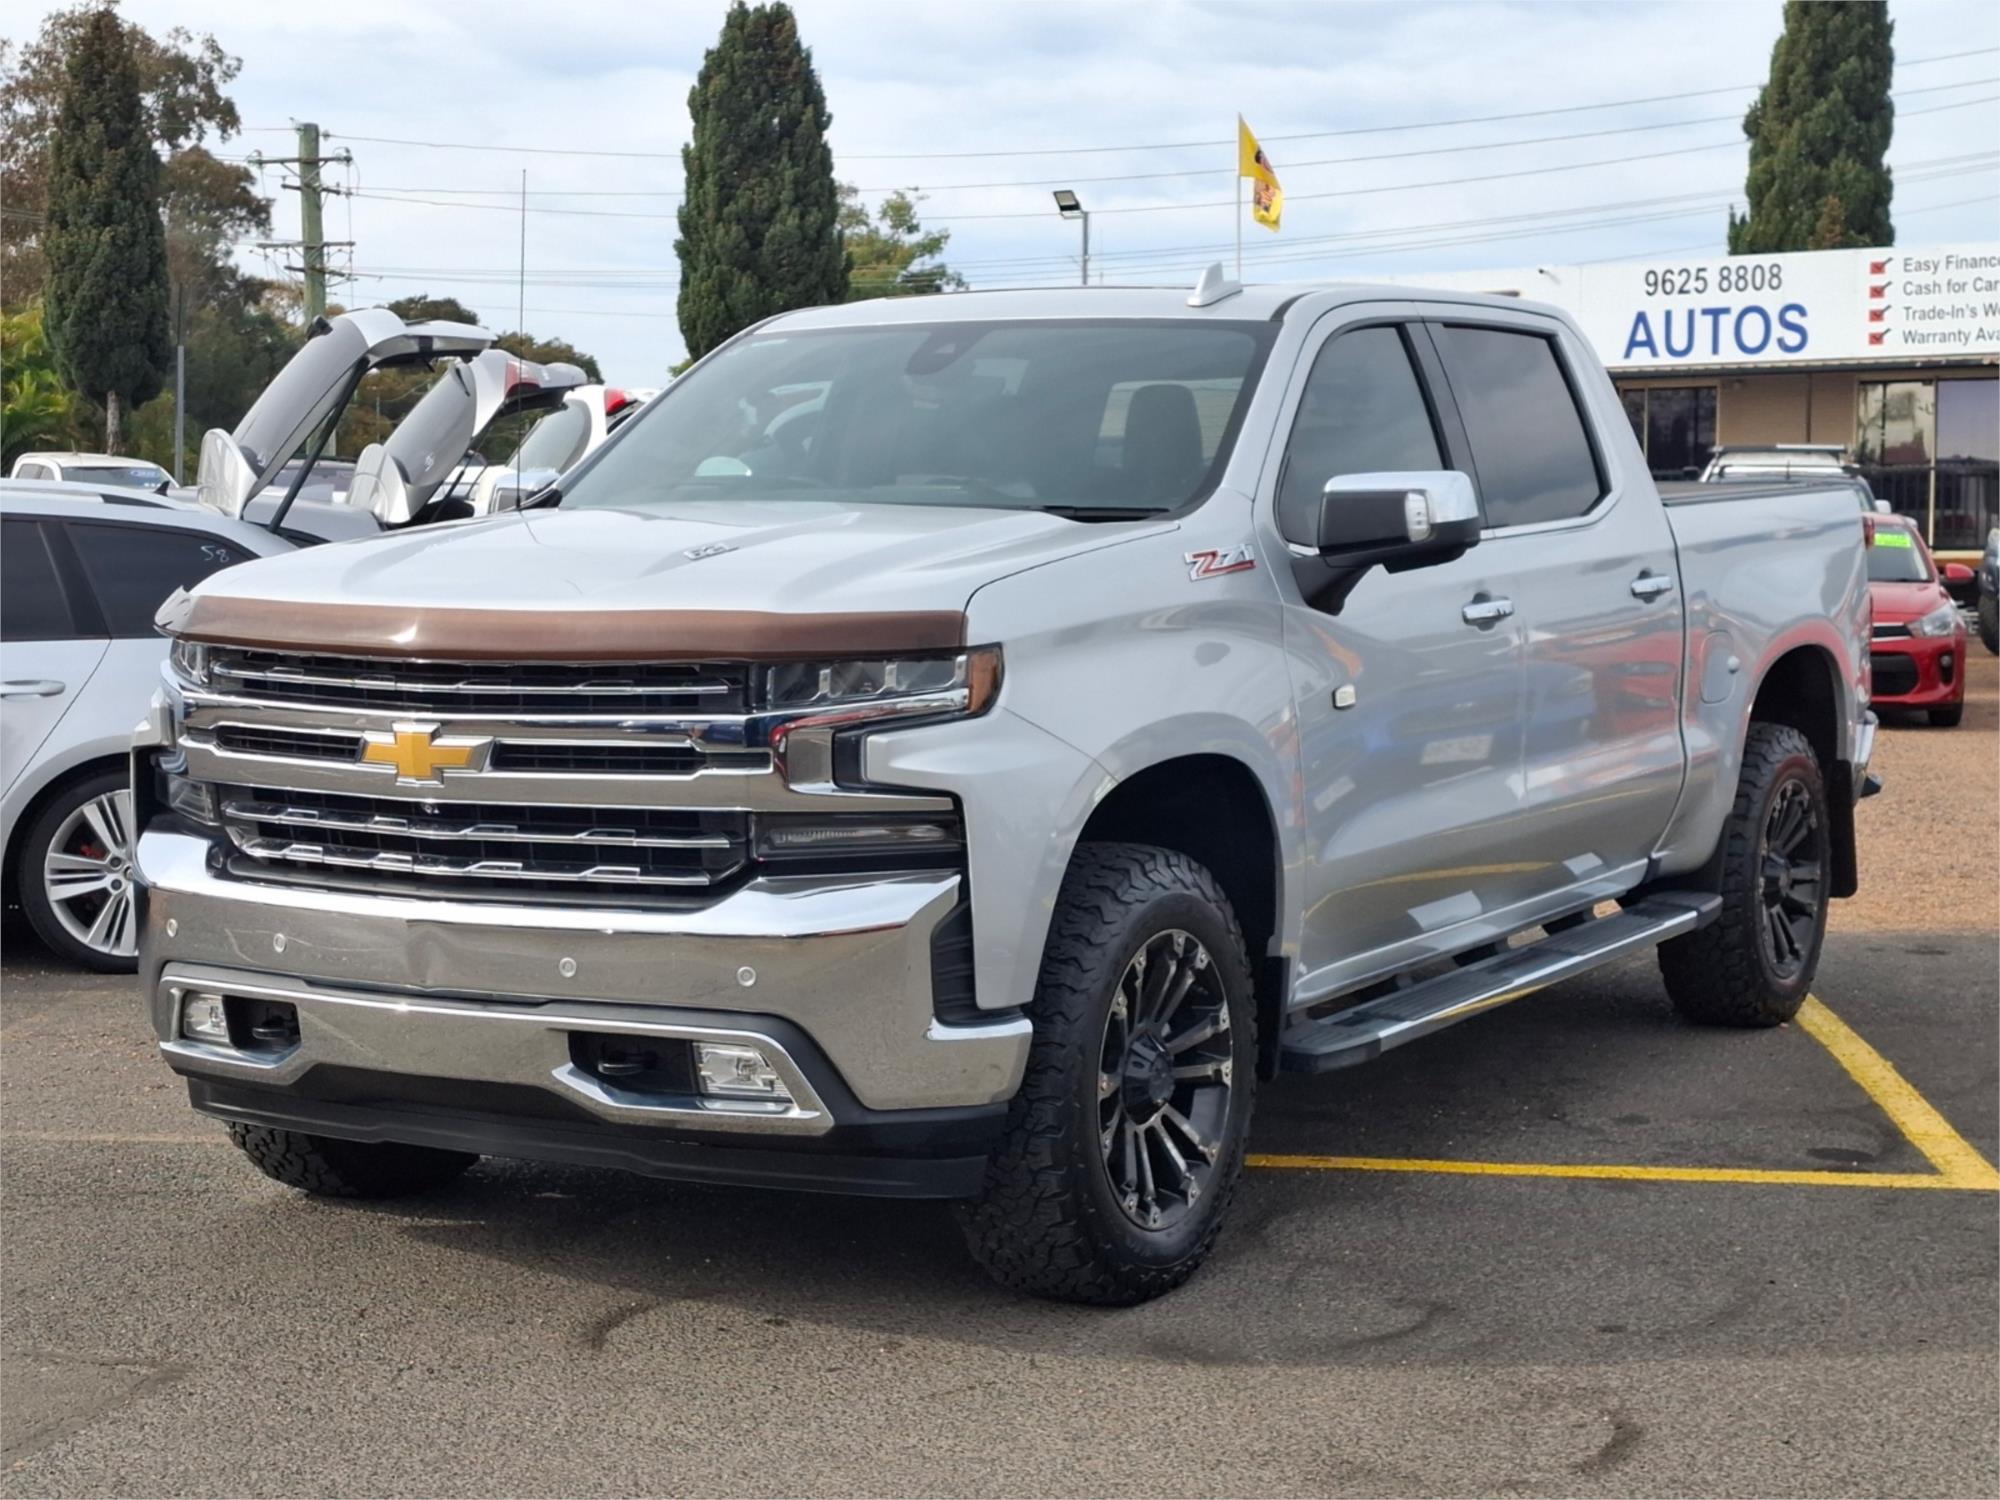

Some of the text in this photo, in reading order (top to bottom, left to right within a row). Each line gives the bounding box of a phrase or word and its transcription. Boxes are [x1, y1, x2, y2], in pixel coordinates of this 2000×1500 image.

[1903, 254, 2000, 275] Easy Financ
[1645, 263, 1783, 296] 9625 8808
[1903, 280, 1942, 296] Cash
[1946, 278, 1967, 294] for
[1903, 303, 1978, 321] Trade-In's
[1623, 303, 1809, 359] AUTOS
[1903, 328, 1971, 346] Warranty
